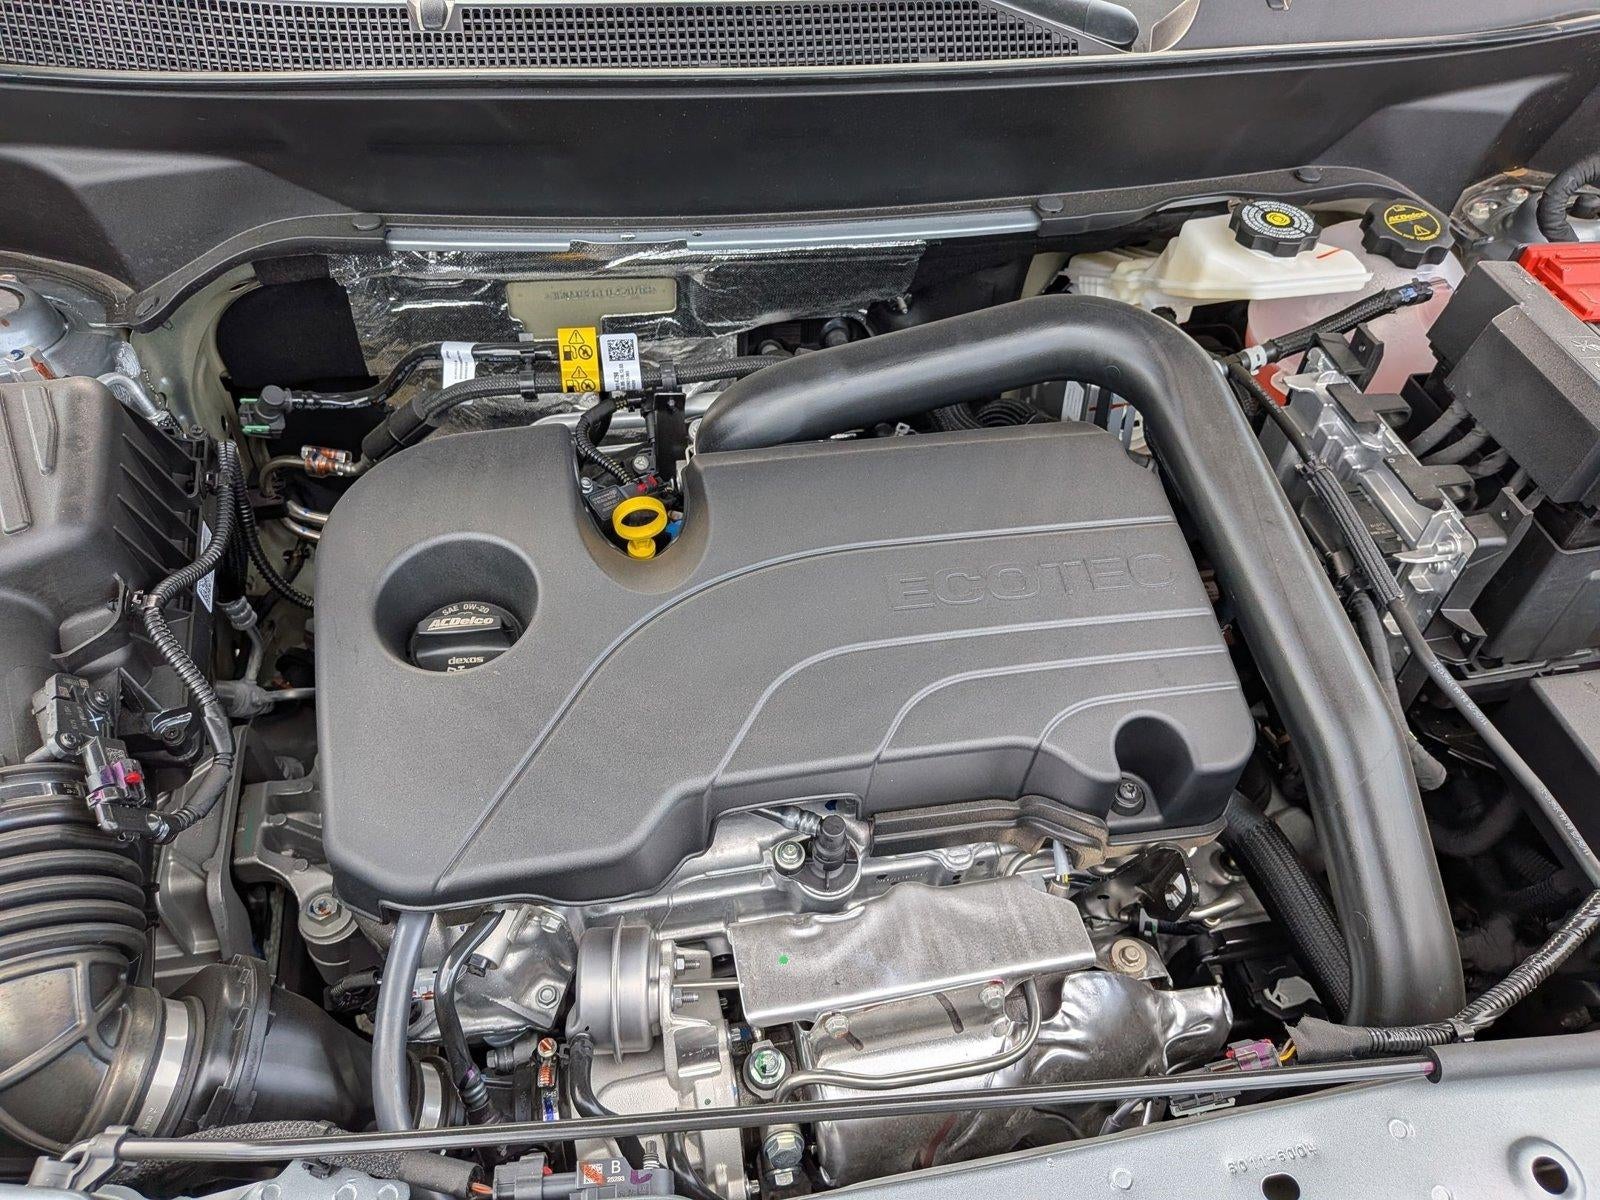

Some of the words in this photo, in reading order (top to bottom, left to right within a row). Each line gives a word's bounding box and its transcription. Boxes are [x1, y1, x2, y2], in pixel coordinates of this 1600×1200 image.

[890, 552, 1178, 612] ECOTEC
[442, 604, 459, 616] SAE
[462, 603, 490, 614] 0W-20
[427, 616, 494, 631] ACDelco
[447, 656, 485, 665] dexos
[611, 1159, 621, 1173] B
